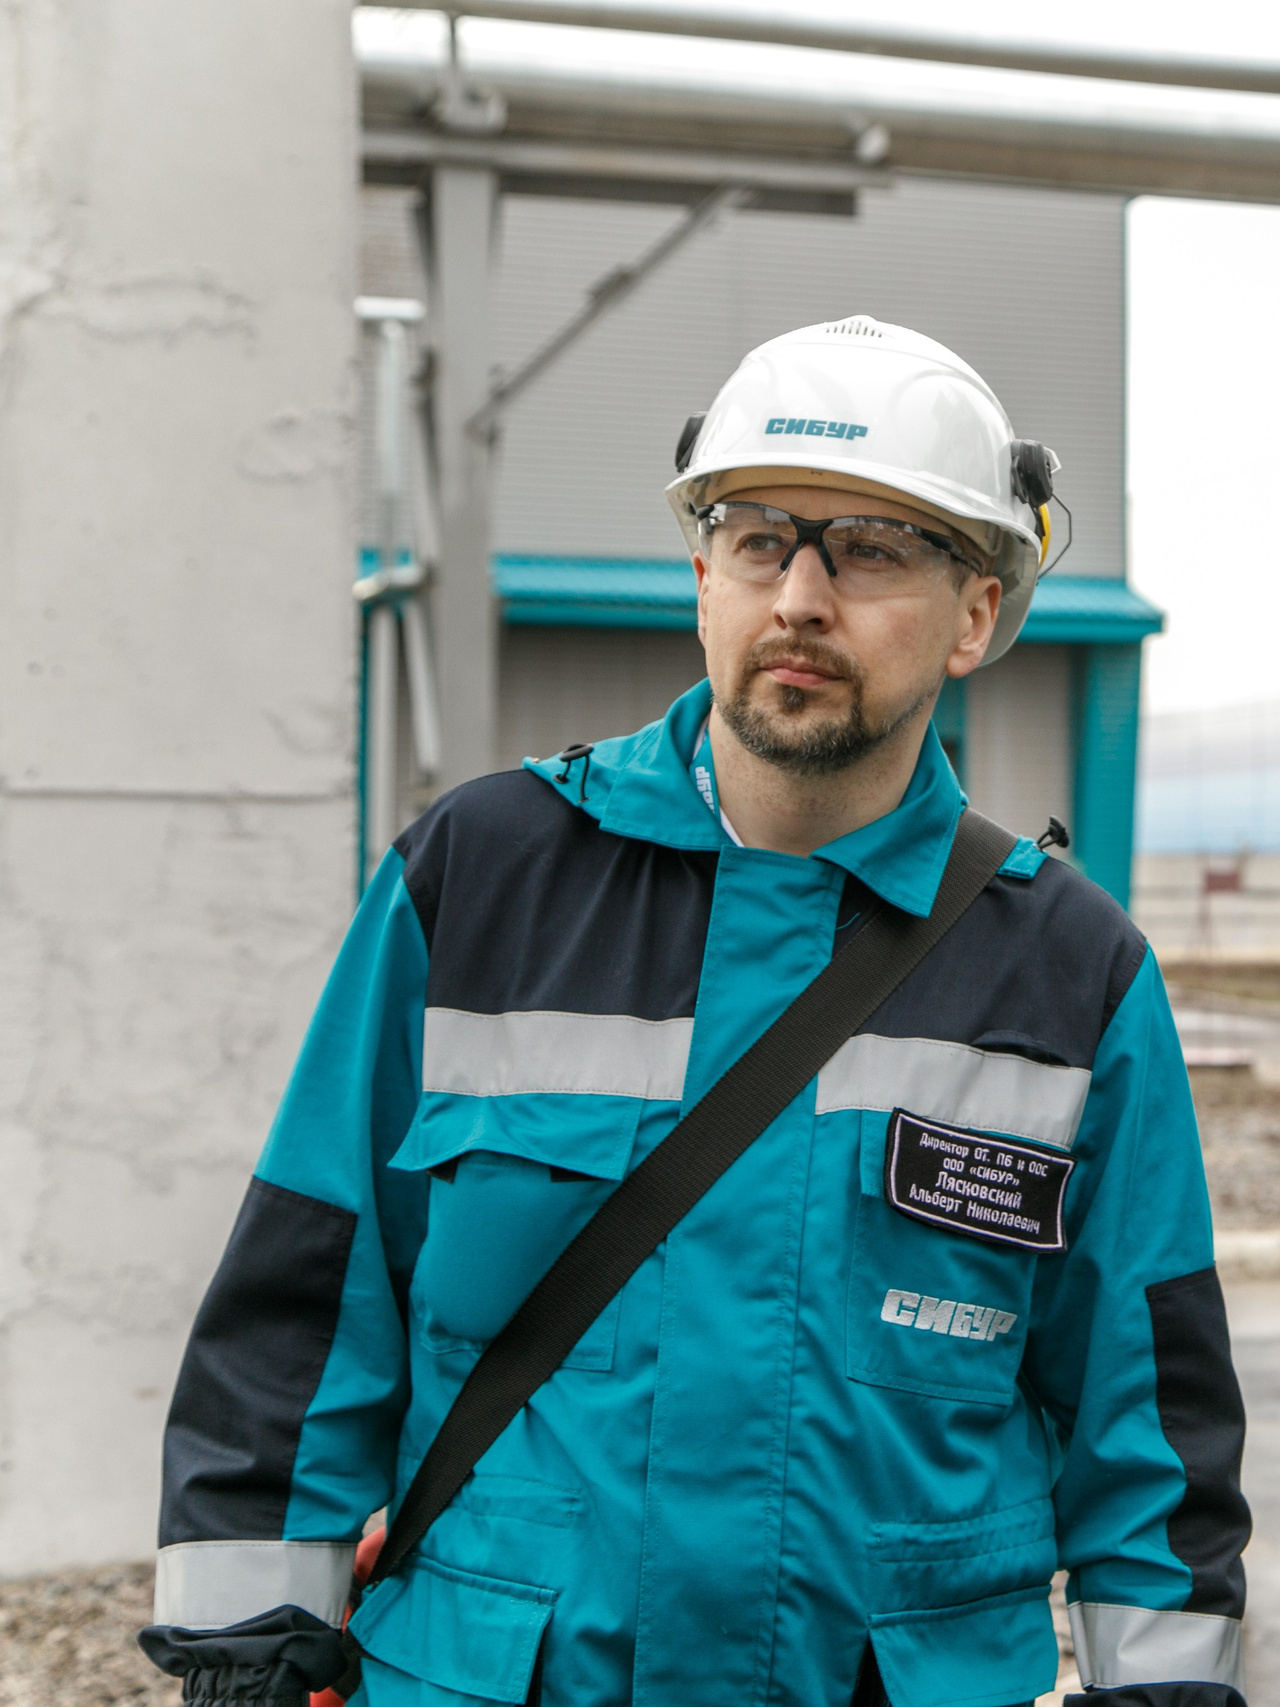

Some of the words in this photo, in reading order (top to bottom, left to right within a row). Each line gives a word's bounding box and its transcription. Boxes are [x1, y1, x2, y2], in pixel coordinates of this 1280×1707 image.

[765, 418, 868, 440] СИБУР
[695, 766, 715, 814] БУР
[919, 1132, 969, 1158] Директор
[996, 1152, 1012, 1168] ПБ
[1017, 1159, 1025, 1170] и
[1028, 1161, 1048, 1177] ООС
[943, 1158, 964, 1173] ООО
[970, 1165, 1020, 1186] «СИБУР»
[909, 1183, 962, 1213] Альберт
[966, 1200, 1040, 1235] Николаевич
[935, 1171, 1022, 1210] Лясковский
[881, 1289, 1018, 1342] СИБУР
